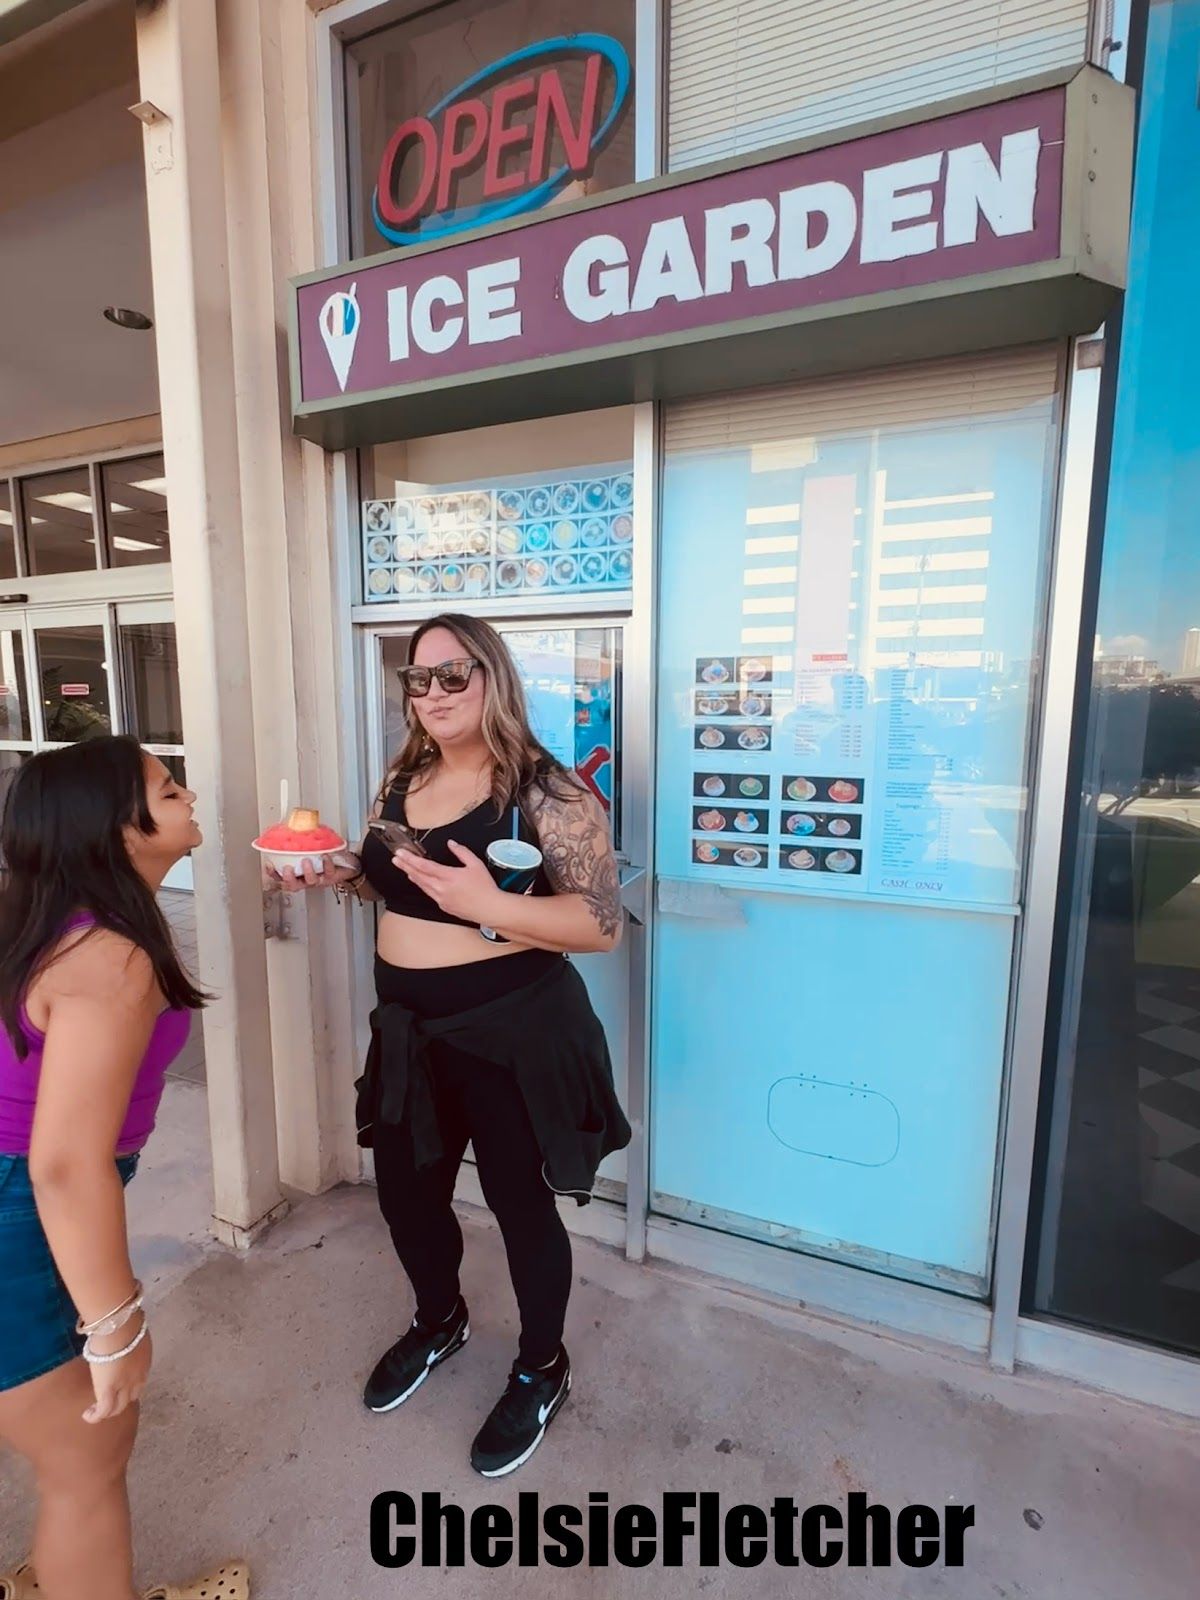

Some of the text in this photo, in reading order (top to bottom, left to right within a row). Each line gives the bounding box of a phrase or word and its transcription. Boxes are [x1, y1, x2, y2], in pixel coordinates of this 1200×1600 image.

[377, 53, 602, 224] OPEN
[387, 127, 1040, 362] ICE GARDEN
